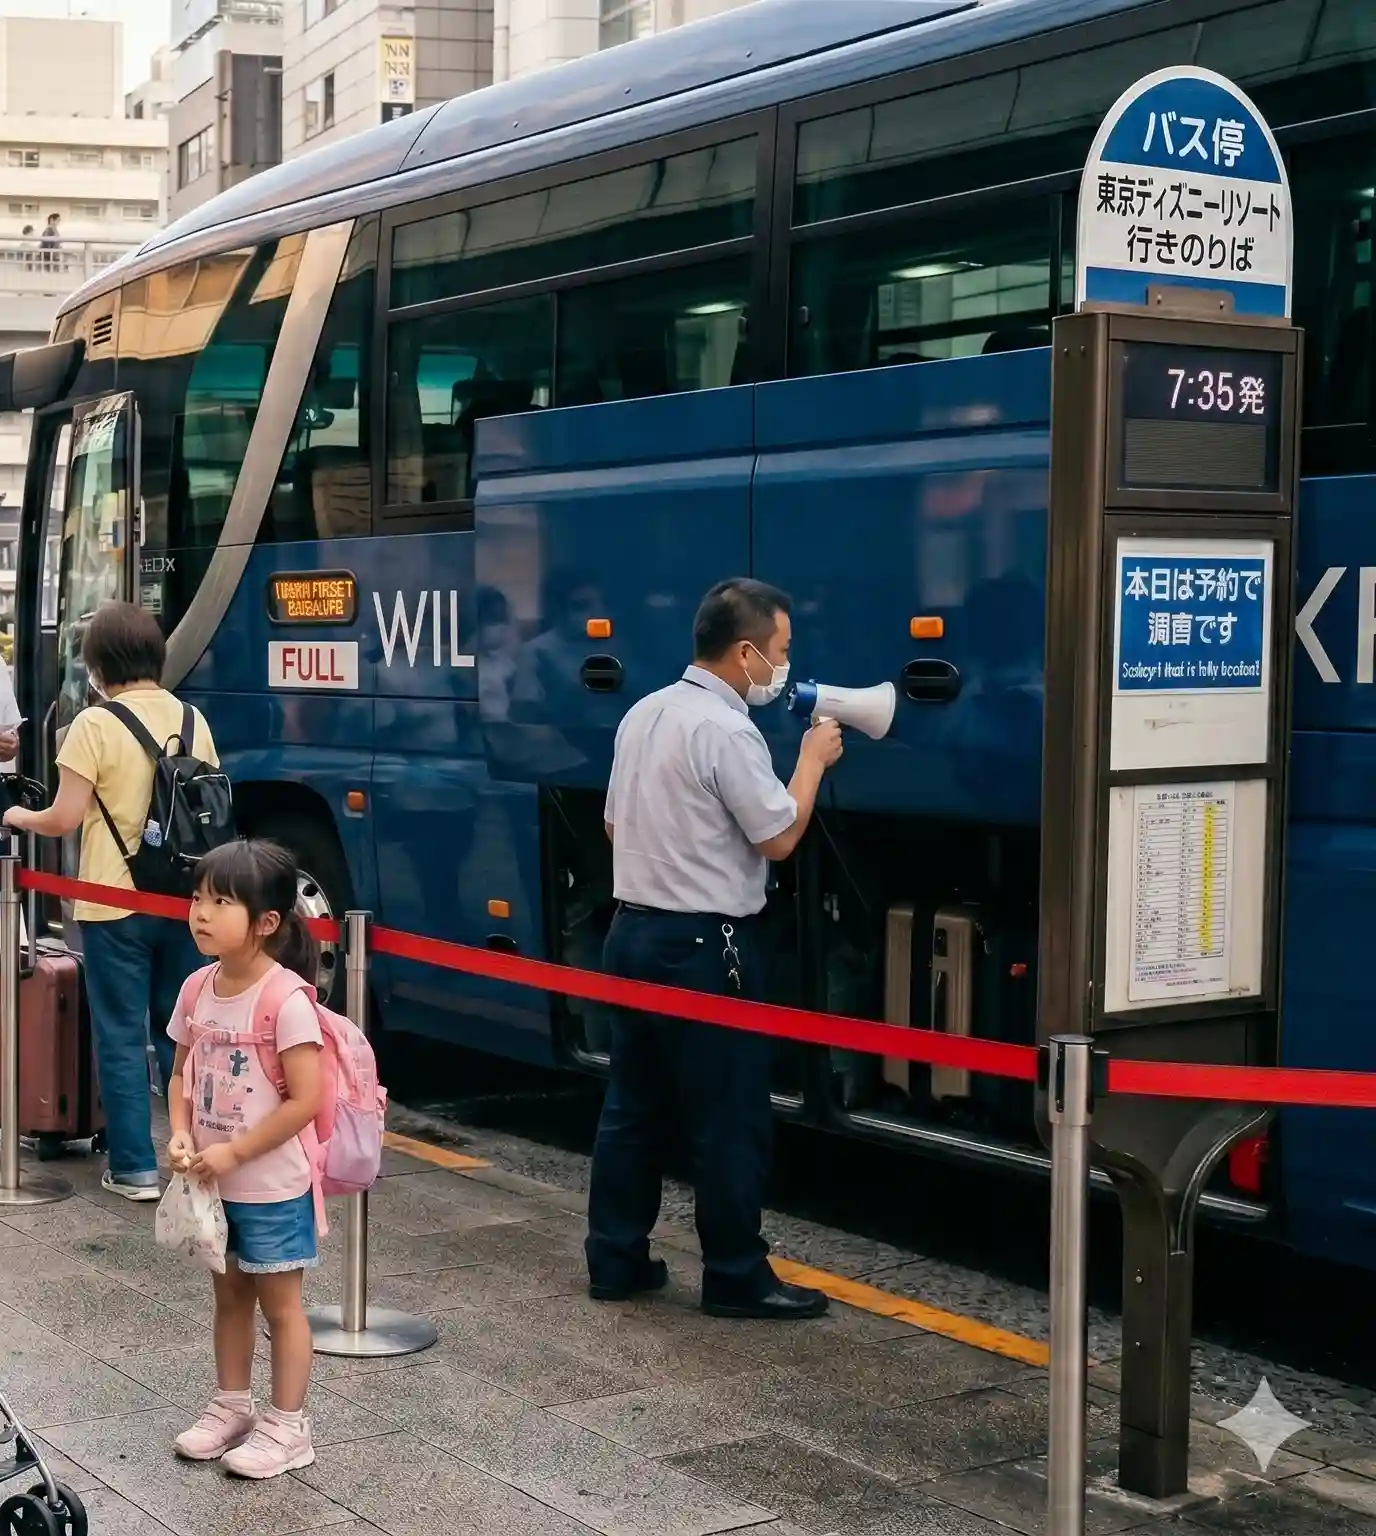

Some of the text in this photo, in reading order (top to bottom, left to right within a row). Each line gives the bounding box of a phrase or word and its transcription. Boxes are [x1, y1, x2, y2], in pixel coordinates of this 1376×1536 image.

[1142, 111, 1246, 167] バス停
[1096, 173, 1281, 232] 東京ディズニーリソート
[1126, 224, 1255, 272] 行きのりば
[1167, 368, 1266, 415] 7:35発
[1124, 566, 1262, 602] 本日は予約で
[372, 590, 475, 668] WIL
[281, 647, 345, 682] FULL
